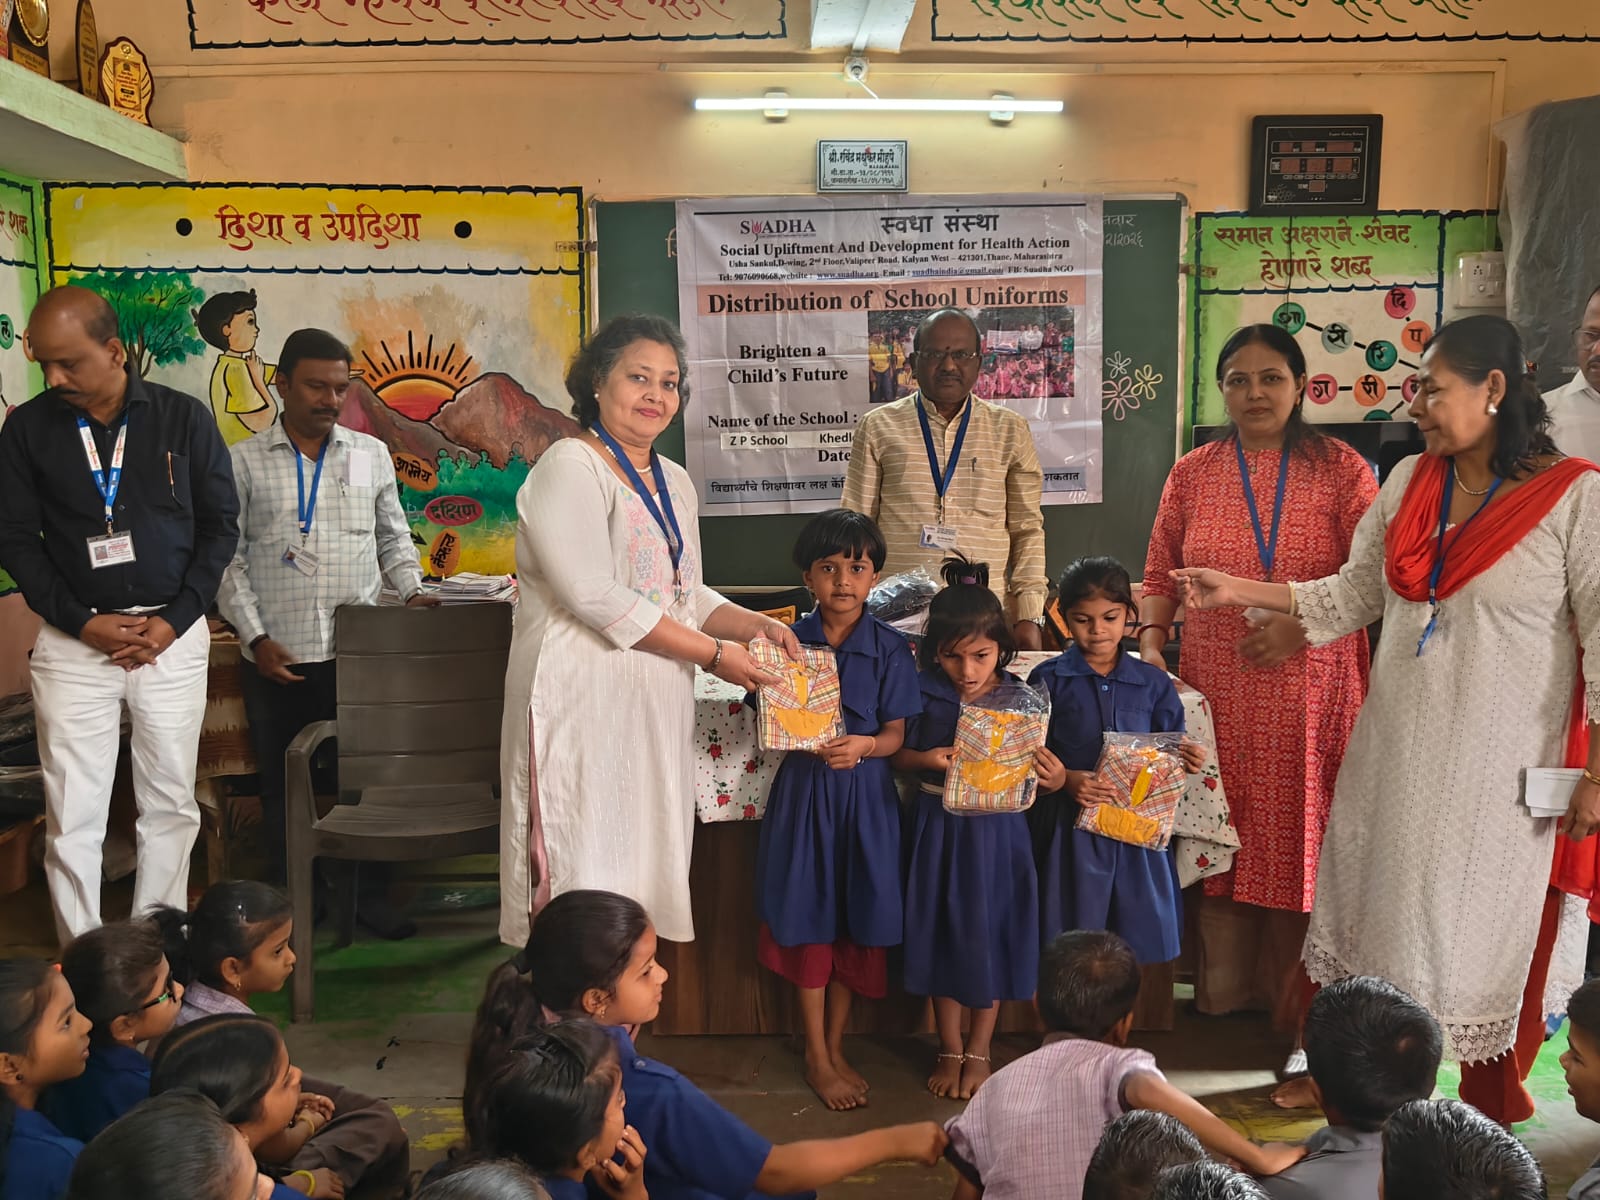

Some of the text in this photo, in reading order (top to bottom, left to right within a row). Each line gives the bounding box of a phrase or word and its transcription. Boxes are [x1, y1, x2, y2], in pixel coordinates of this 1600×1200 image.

[214, 203, 422, 251] दिशा व उपदिशा
[881, 208, 1000, 234] स्वधा संस्था
[1214, 225, 1274, 250] समान
[1361, 218, 1412, 244] शेवट
[720, 236, 1070, 259] Social Upliftment And Development for Health Action
[729, 259, 748, 268] Usha
[902, 255, 929, 266] Kalyan
[931, 254, 949, 263] West
[1014, 252, 1063, 262] Maharashtra
[1331, 254, 1381, 283] शब्द
[882, 268, 905, 277] Email
[1008, 266, 1022, 274] FB:
[1024, 265, 1052, 273] Suadha
[1054, 265, 1074, 273] NGO
[709, 285, 1069, 314] Distribution of School Uniforms
[1408, 328, 1424, 346] प
[739, 344, 827, 362] Brighten a
[727, 366, 849, 385] Child’s Future
[708, 415, 750, 428] Name
[754, 413, 771, 427] of
[773, 413, 795, 426] the
[800, 411, 848, 425] School
[730, 436, 737, 446] Z
[740, 435, 747, 446] P
[750, 434, 788, 446] School
[818, 450, 851, 462] Date
[762, 478, 806, 492] शिक्षणावर
[809, 479, 828, 490] लक्ष
